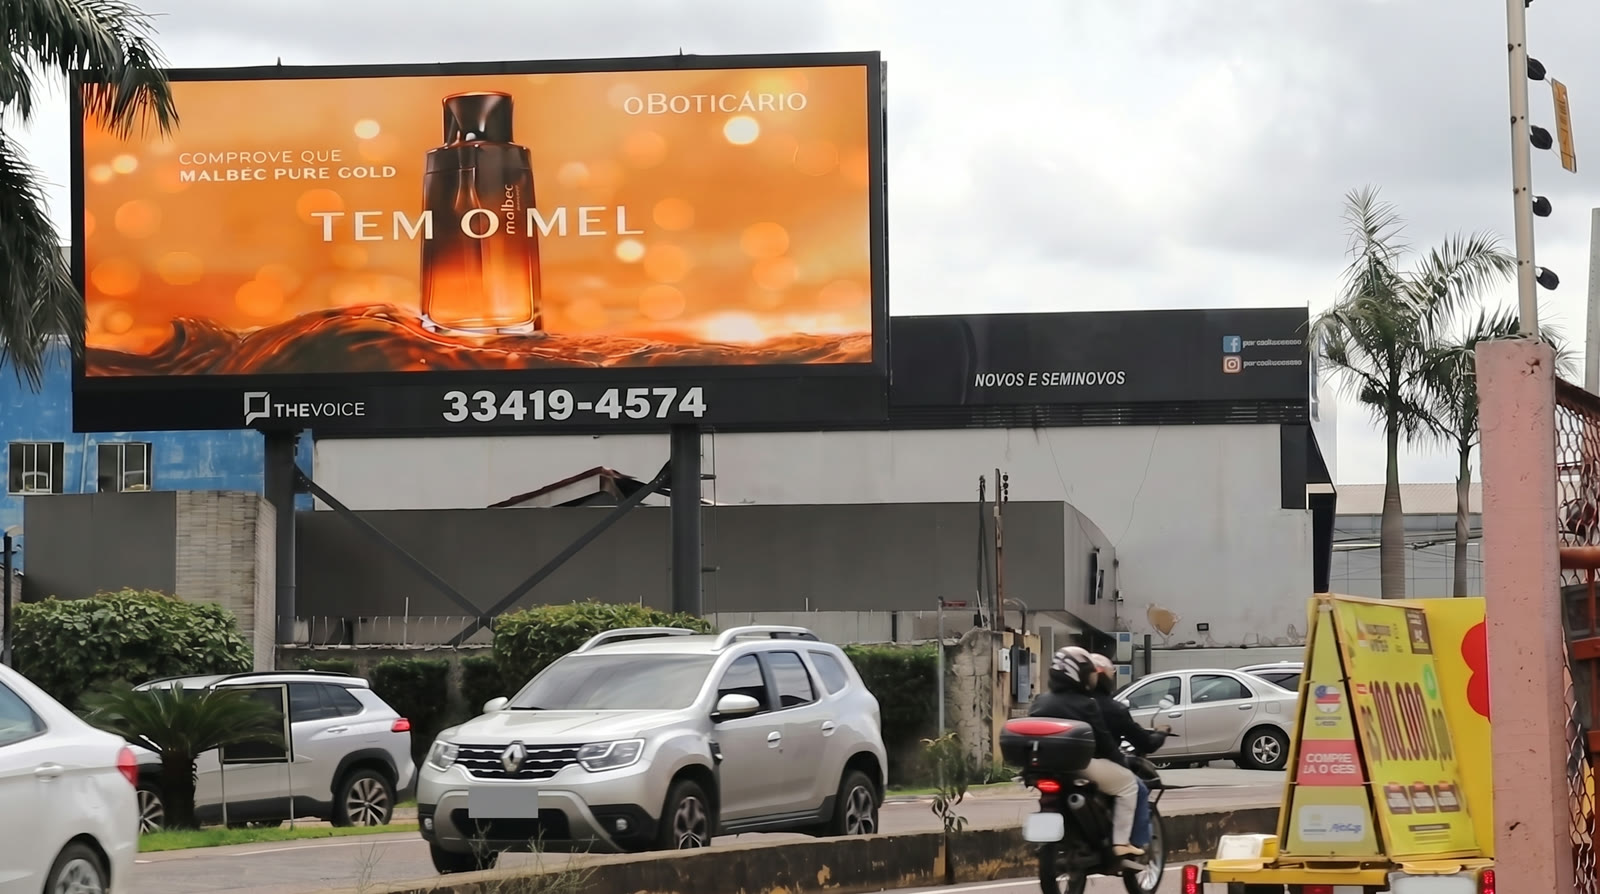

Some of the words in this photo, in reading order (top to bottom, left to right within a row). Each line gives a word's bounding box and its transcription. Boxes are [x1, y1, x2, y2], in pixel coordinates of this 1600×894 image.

[179, 151, 293, 165] COMPROVE
[301, 150, 342, 165] QUE
[274, 167, 330, 180] PURE
[337, 166, 397, 179] GOLD
[500, 184, 516, 235] malbec
[311, 210, 434, 242] TEM
[460, 208, 500, 239] O
[526, 205, 645, 237] MEL
[975, 373, 1025, 387] NOVOS
[1028, 372, 1038, 386] E
[1041, 371, 1126, 386] SEMINOVOS
[442, 387, 707, 422] 33419-4574
